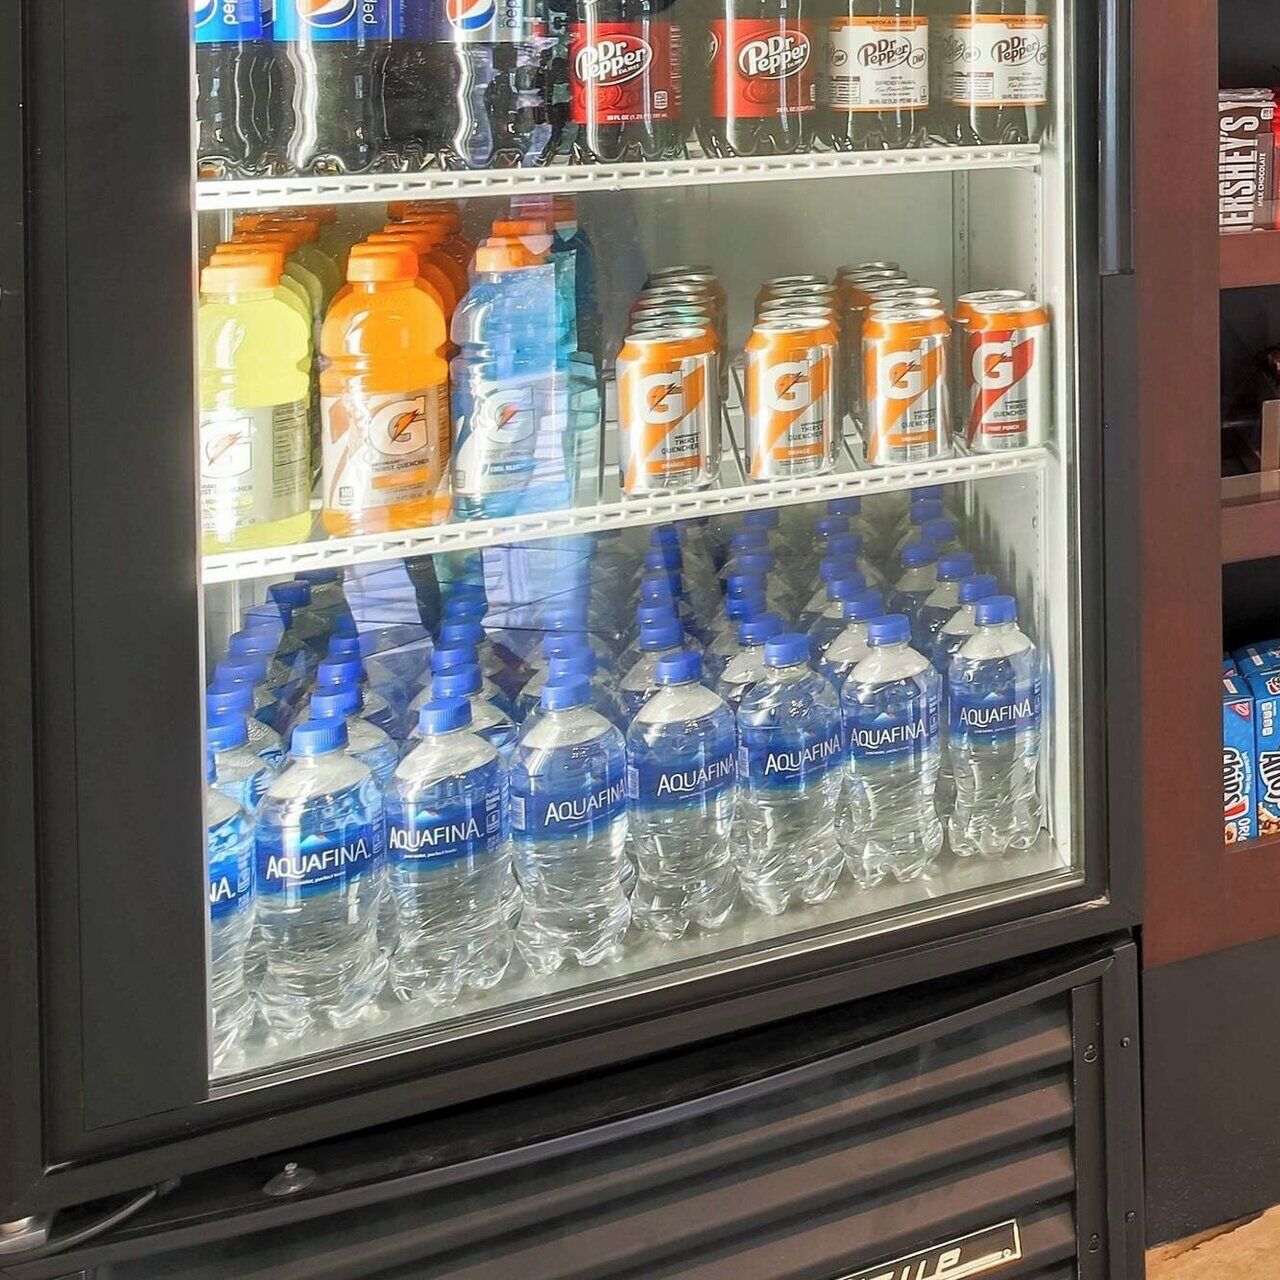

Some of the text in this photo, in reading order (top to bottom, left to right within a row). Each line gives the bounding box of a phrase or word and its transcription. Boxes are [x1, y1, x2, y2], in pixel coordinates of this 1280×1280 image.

[597, 40, 628, 58] Dr
[743, 41, 808, 76] Pepper
[769, 35, 795, 52] Dr
[862, 42, 910, 67] Pepper
[877, 38, 897, 52] Dr
[911, 52, 927, 66] Diet
[996, 41, 1040, 65] Pepper
[1010, 36, 1028, 50] Dr
[579, 45, 647, 83] Pepper
[1258, 153, 1267, 190] CHOCOLATE
[879, 348, 924, 400] G
[971, 339, 1017, 390] G
[639, 369, 685, 425] G
[765, 358, 813, 411] G
[368, 394, 429, 456] G
[675, 436, 700, 445] THIRST
[787, 431, 823, 443] QUENCHER
[661, 442, 700, 455] QUENCHER
[959, 698, 1033, 729] AQUAFINA
[850, 718, 928, 750] AQUAFINA
[764, 734, 841, 776] AQUAFINA
[656, 752, 735, 797] AQUAFINA
[544, 776, 629, 826] AQUAFINA
[389, 817, 484, 851] AQUAFINA
[266, 838, 371, 881] AQUAFINA
